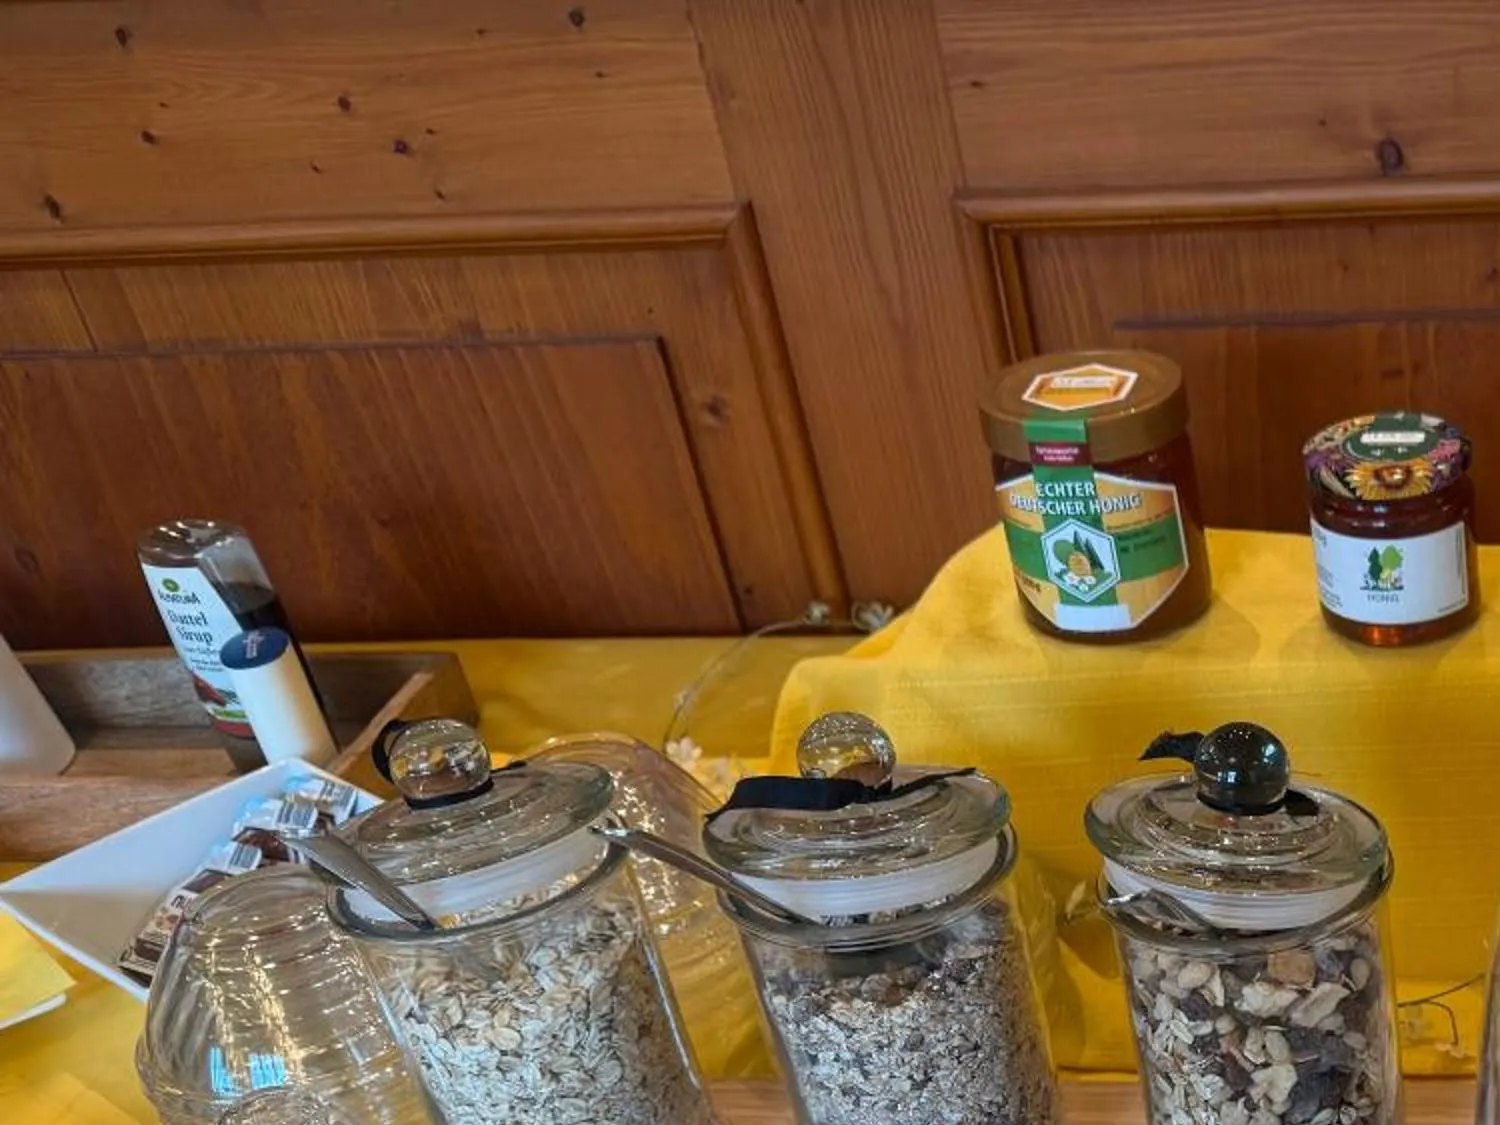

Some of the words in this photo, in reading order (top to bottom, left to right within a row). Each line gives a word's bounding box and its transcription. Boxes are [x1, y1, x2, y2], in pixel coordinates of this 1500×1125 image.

[1035, 480, 1095, 497] ECHTER
[1009, 493, 1086, 516] DEUTSCHER
[1090, 494, 1143, 515] HONIG
